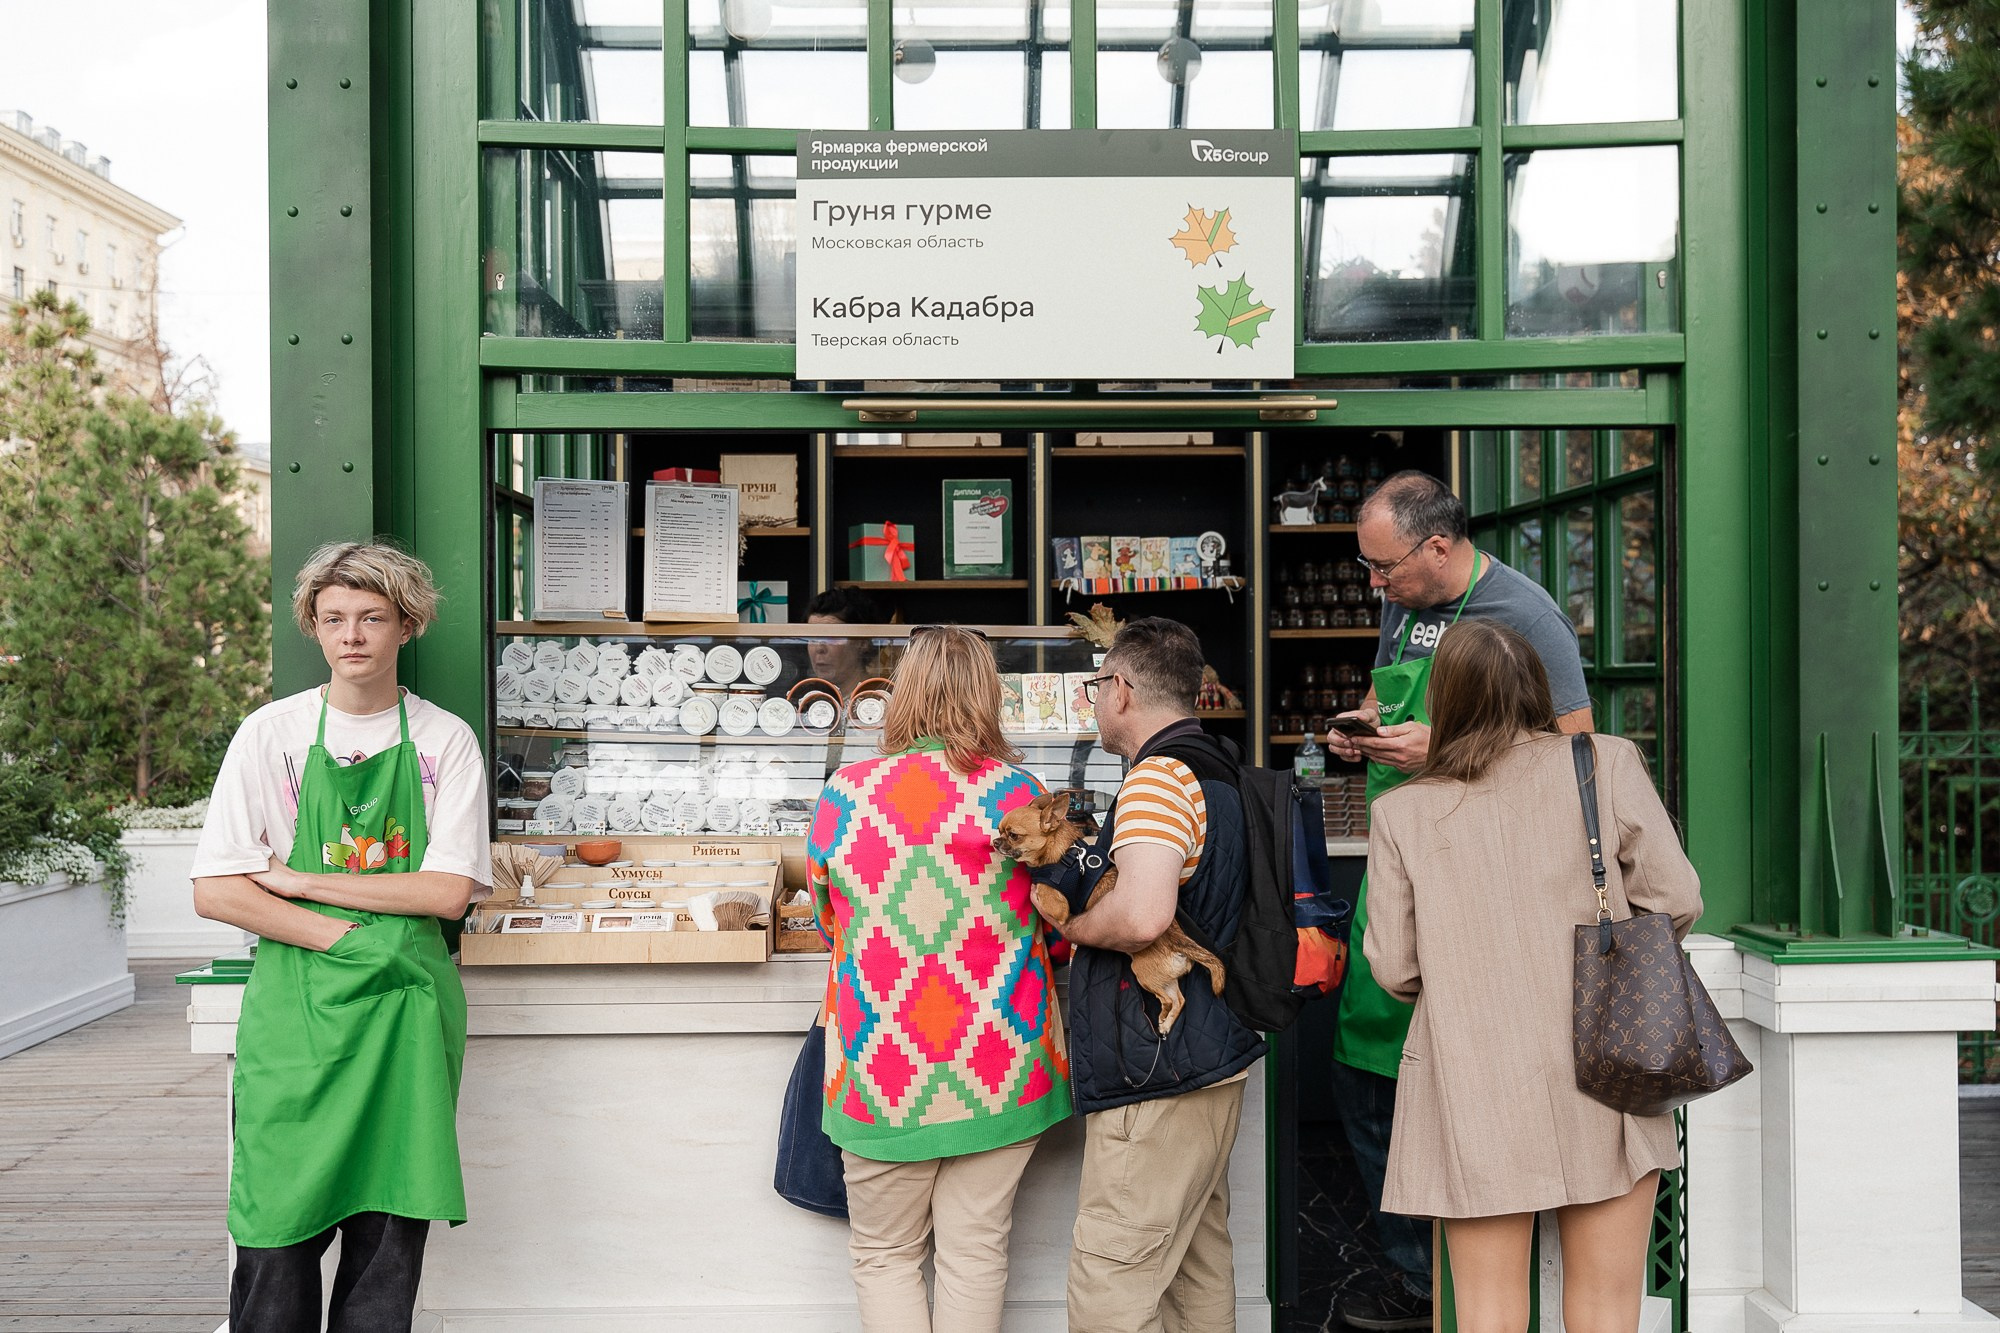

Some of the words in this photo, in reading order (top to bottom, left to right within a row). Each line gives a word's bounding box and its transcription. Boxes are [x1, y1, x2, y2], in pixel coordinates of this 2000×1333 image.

[811, 140, 882, 156] Ярмарка
[885, 138, 988, 156] фермерской
[811, 158, 899, 174] продукции
[812, 199, 896, 227] Груня
[905, 203, 992, 227] гурме
[811, 235, 912, 250] Московская
[916, 234, 984, 250] область
[812, 295, 901, 324] Кабра
[911, 294, 1035, 323] Кадабра
[811, 333, 888, 350] Тверская
[892, 332, 960, 347] область
[741, 483, 777, 493] ГРУНЯ
[692, 845, 741, 857] Рийеты
[611, 867, 663, 881] Хумусы
[608, 887, 652, 901] Соусы
